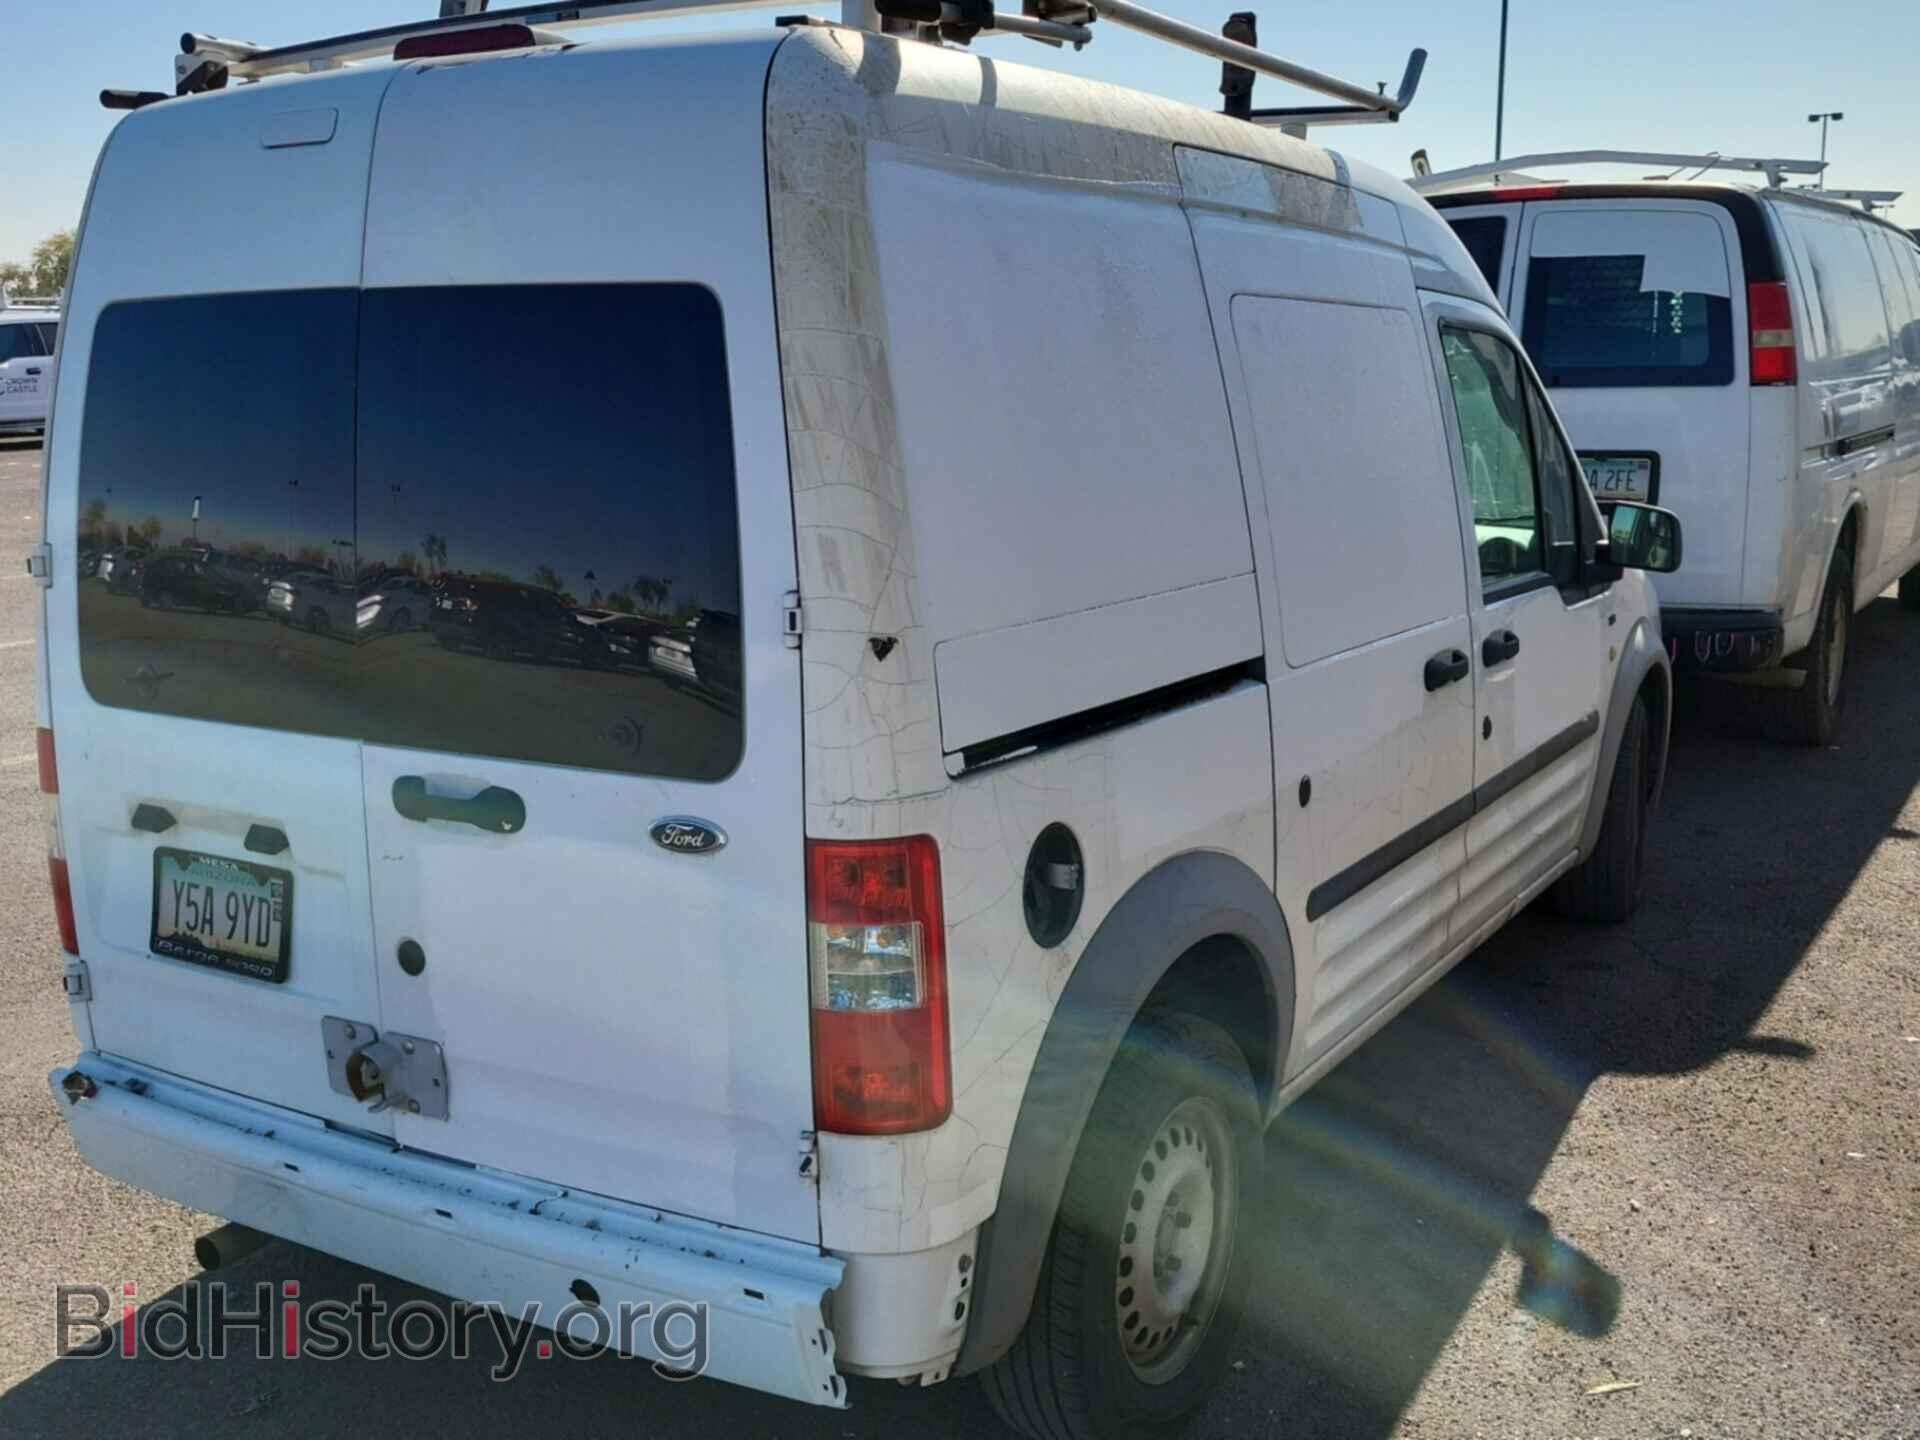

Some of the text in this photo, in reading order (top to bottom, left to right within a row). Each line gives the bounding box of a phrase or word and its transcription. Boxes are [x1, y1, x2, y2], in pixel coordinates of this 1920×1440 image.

[1604, 469, 1636, 491] 2FE
[661, 823, 705, 848] Ford
[173, 879, 214, 936] Y5A
[225, 890, 272, 948] 9YD
